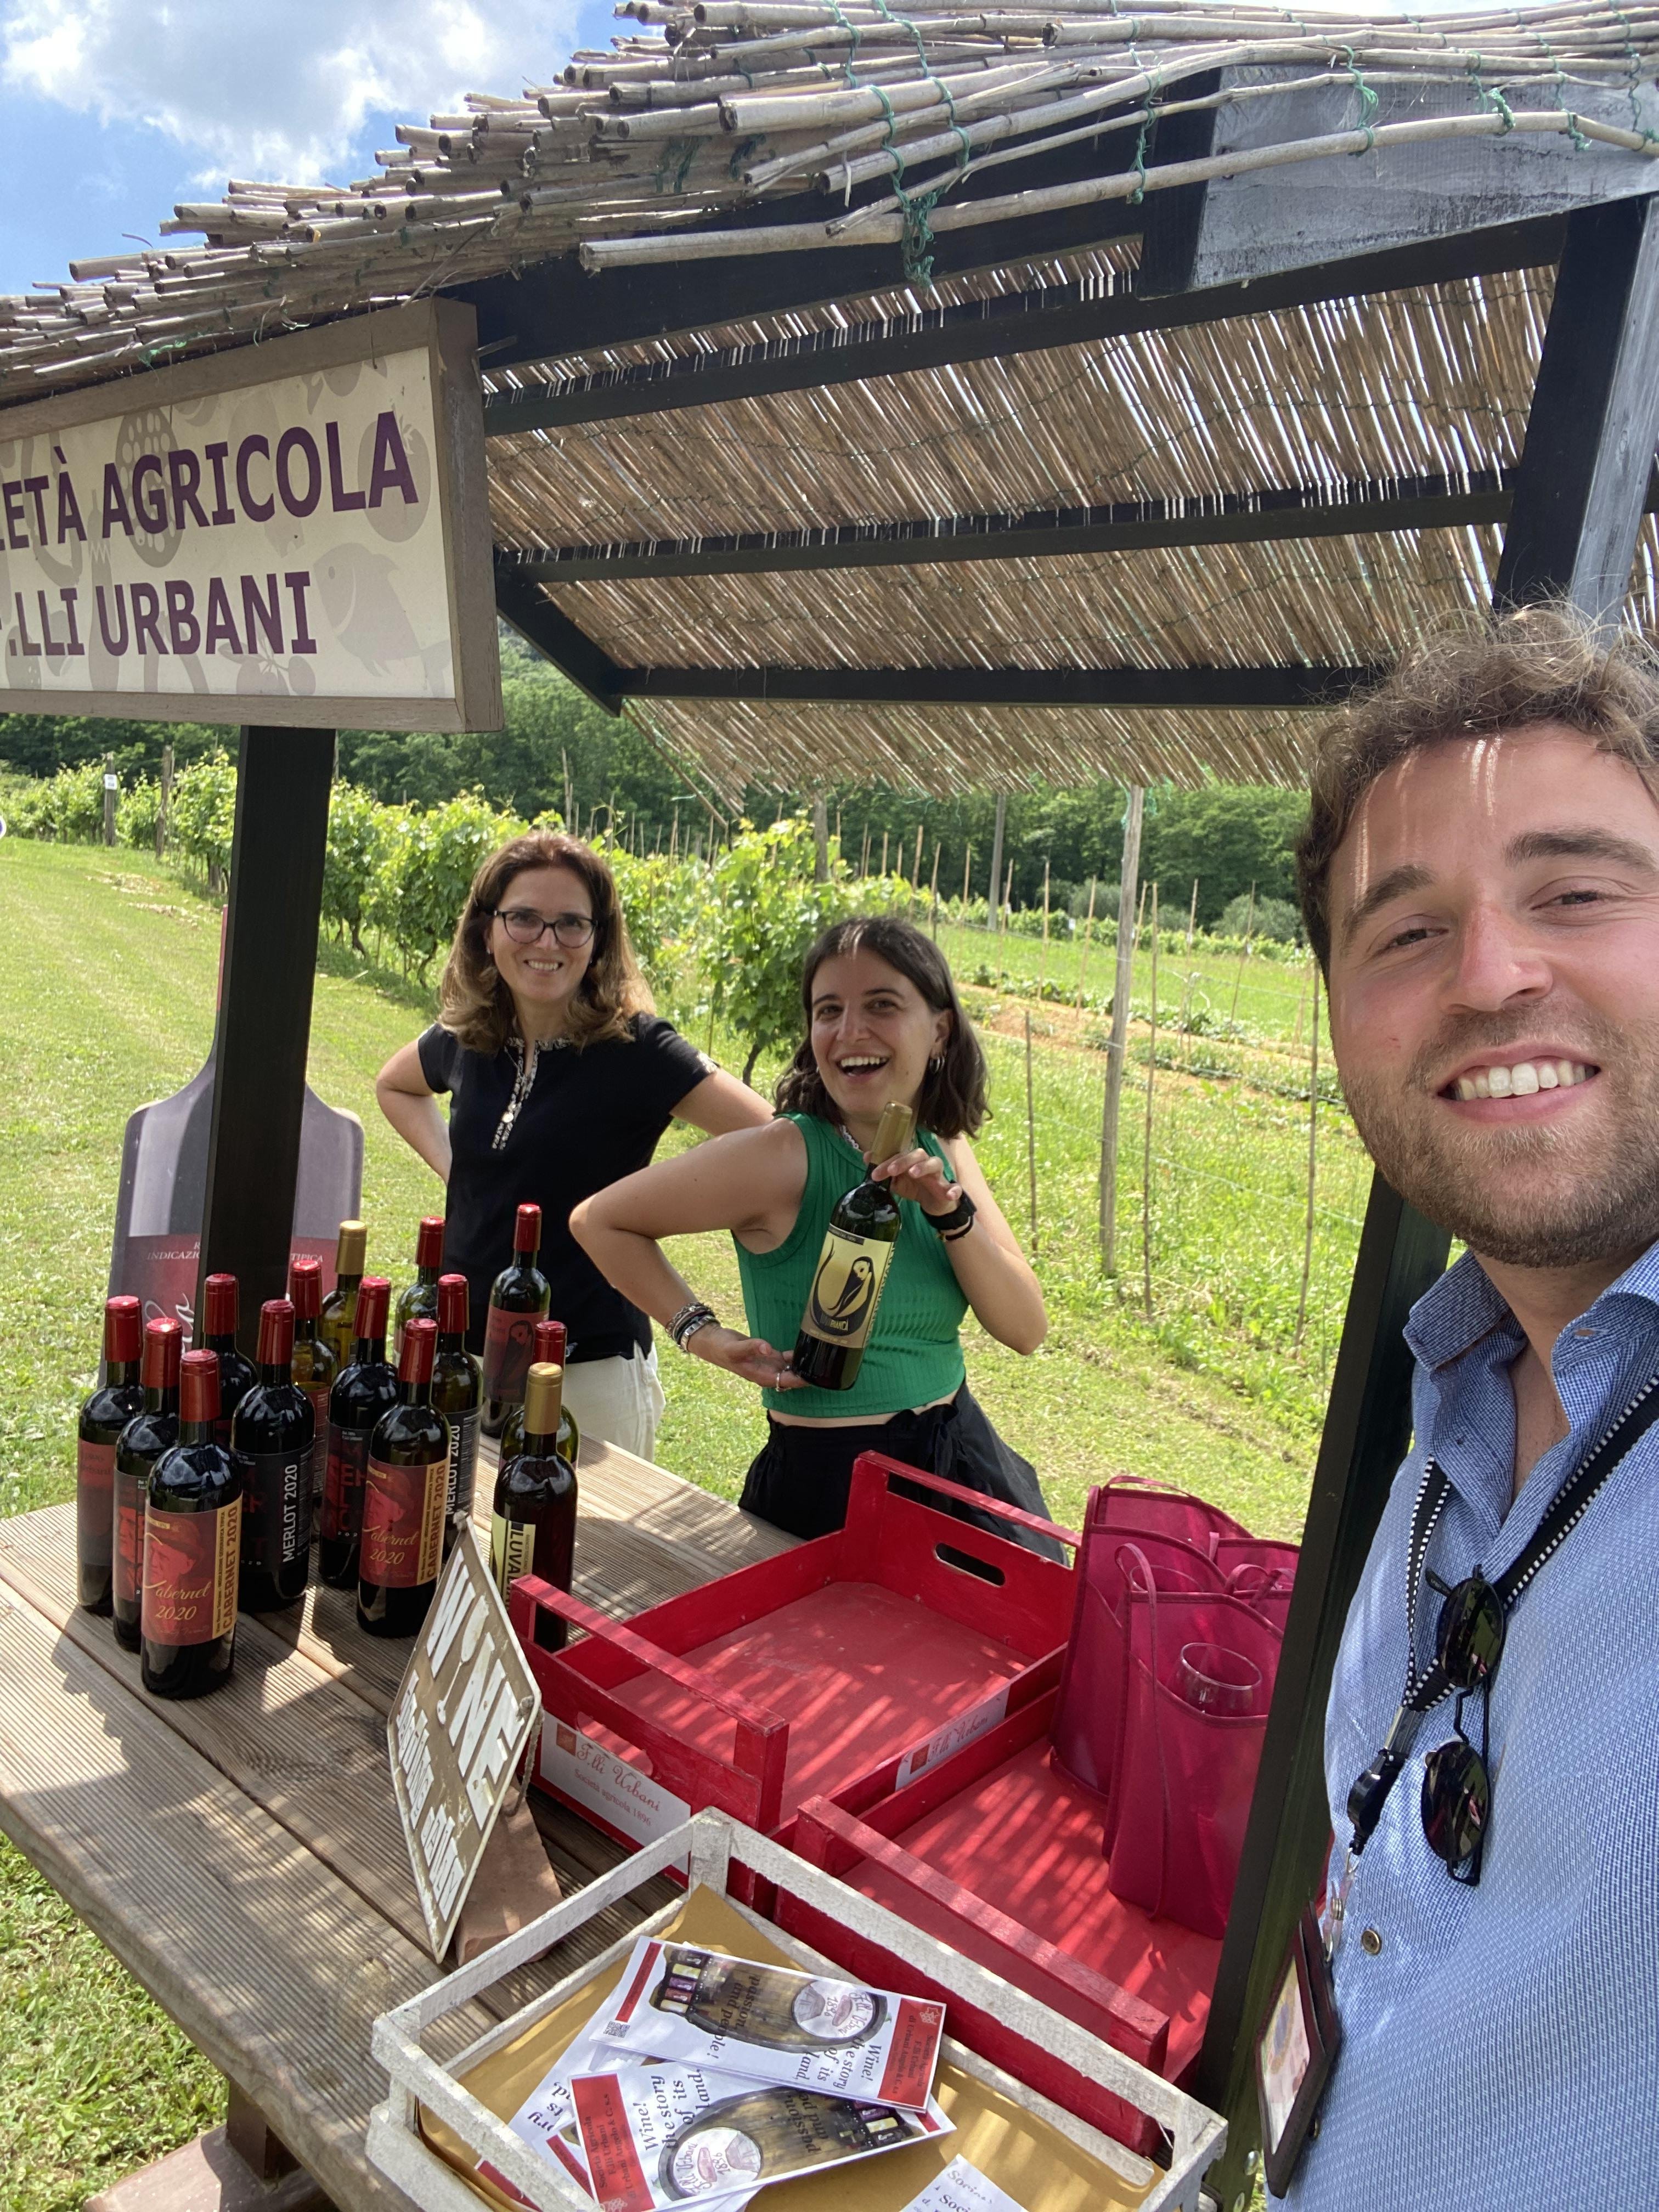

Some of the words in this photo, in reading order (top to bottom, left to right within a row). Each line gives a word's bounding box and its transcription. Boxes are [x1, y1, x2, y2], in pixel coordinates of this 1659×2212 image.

[0, 446, 87, 549] ETÀ
[102, 411, 419, 539] AGRICOLA
[0, 588, 85, 656] .LLI
[95, 571, 317, 657] URBANI
[284, 1464, 298, 1501] 2020
[227, 1506, 237, 1547] 2020
[283, 1505, 297, 1562] MERLOT
[427, 1506, 441, 1578] CABERNET
[434, 1465, 445, 1501] 2020
[369, 1549, 405, 1564] 2020
[223, 1551, 236, 1629] CABERNET
[155, 1606, 196, 1621] 2020
[577, 1743, 607, 1774] F.lli
[613, 1765, 660, 1811] Urbani
[602, 1789, 630, 1813] agricola
[726, 1982, 744, 2010] and
[822, 2046, 842, 2064] of
[862, 2044, 881, 2081] Wine!
[673, 2080, 687, 2100] its
[817, 2066, 834, 2083] its
[833, 2058, 854, 2090] story
[651, 2075, 672, 2118] story
[633, 2103, 658, 2150] Wine!
[674, 2108, 695, 2124] of
